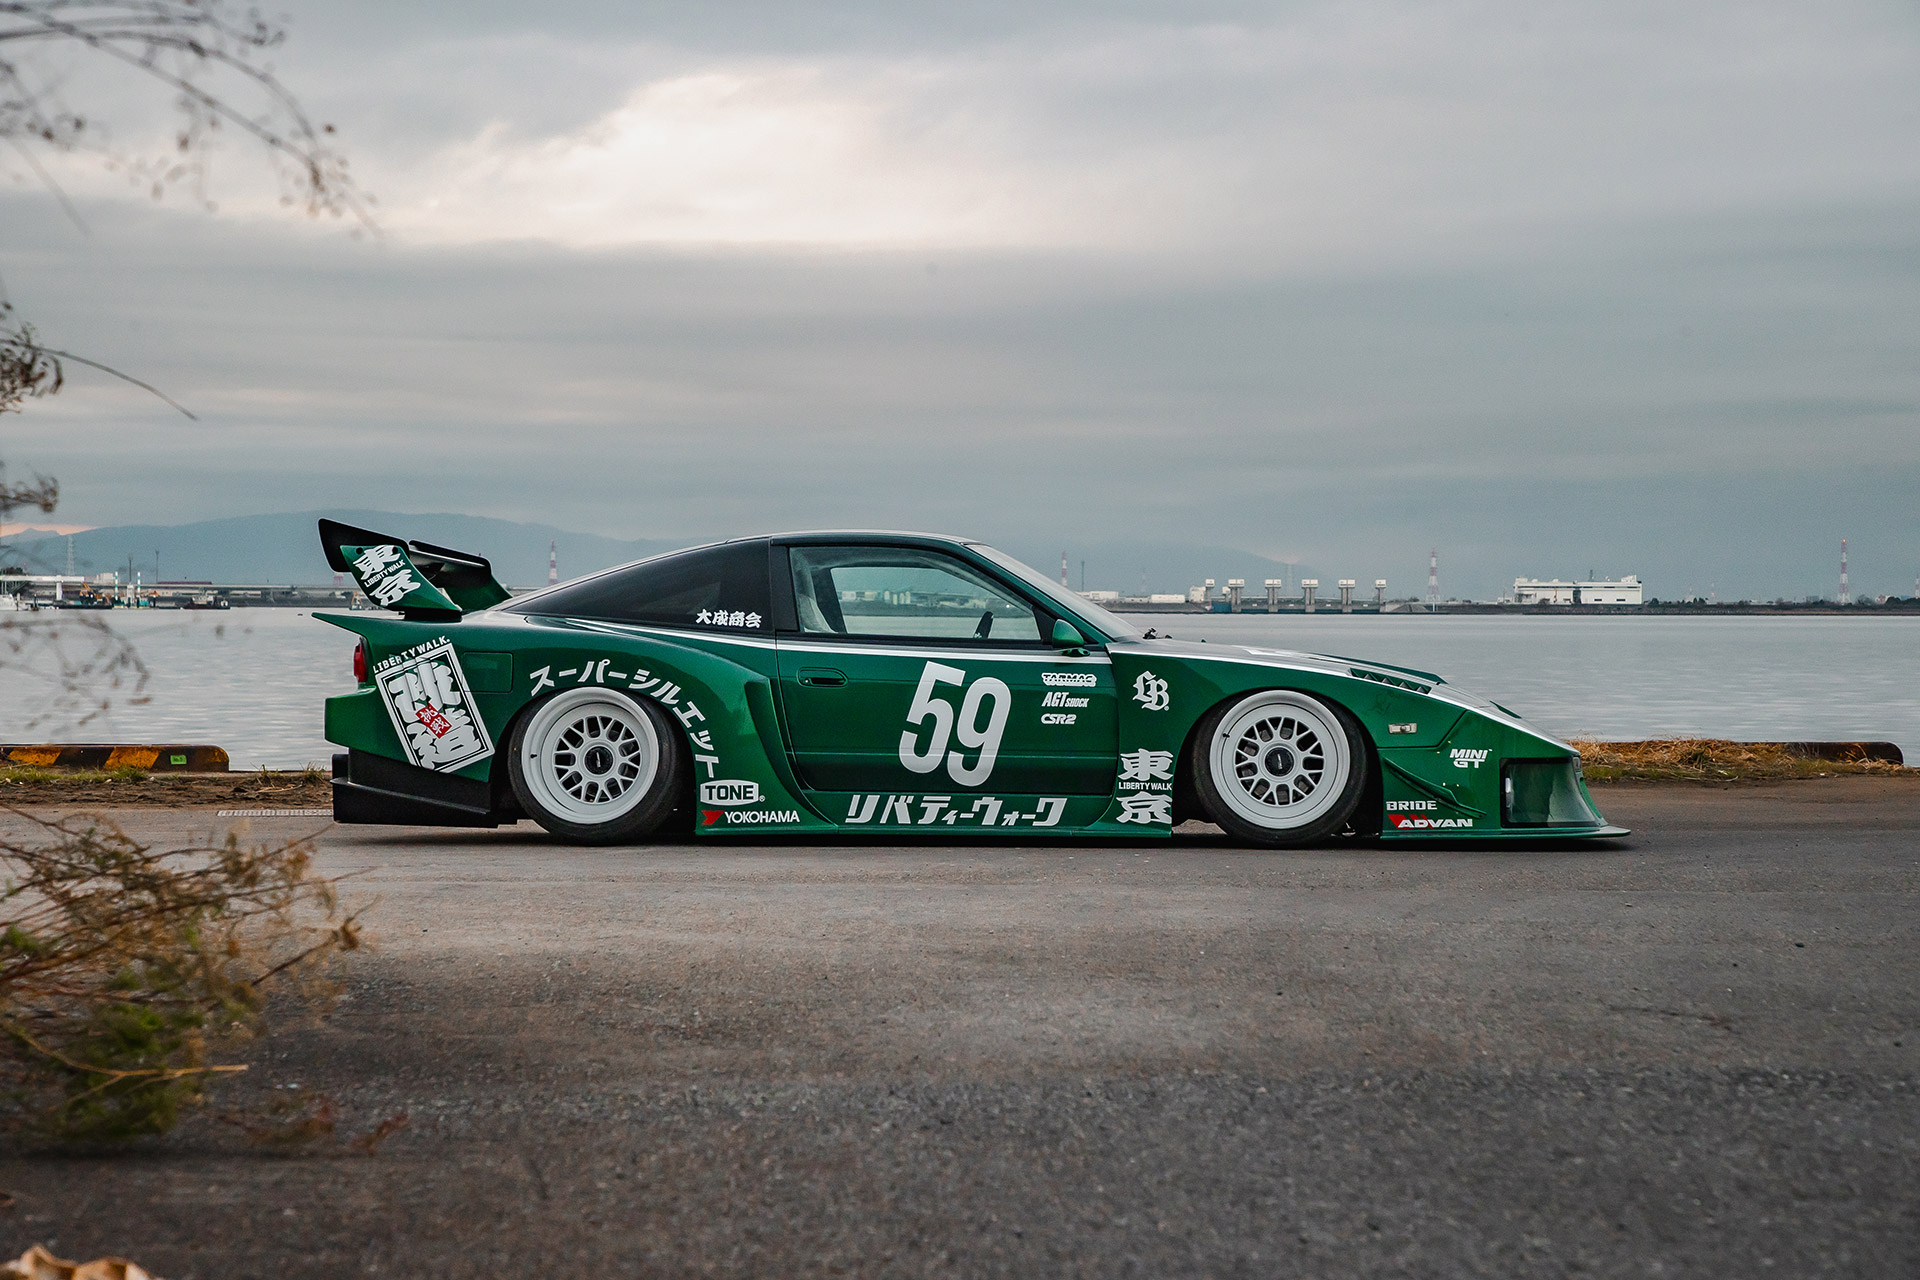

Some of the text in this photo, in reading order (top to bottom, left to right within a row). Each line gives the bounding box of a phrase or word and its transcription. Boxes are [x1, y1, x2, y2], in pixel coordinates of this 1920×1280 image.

[364, 559, 406, 587] LIBERTY WALK
[695, 608, 762, 628] 大成商会
[898, 660, 1012, 787] 59
[1041, 713, 1077, 725] CSR2
[1449, 749, 1488, 759] MINI
[1453, 758, 1485, 769] GT
[705, 785, 754, 801] TONE
[1118, 782, 1173, 791] LIBERTY WALK
[845, 794, 1068, 827] リバティーウォーク
[1386, 800, 1438, 811] BRIDE
[724, 810, 800, 824] YOKOHAMA
[1397, 818, 1473, 828] ADVAN
